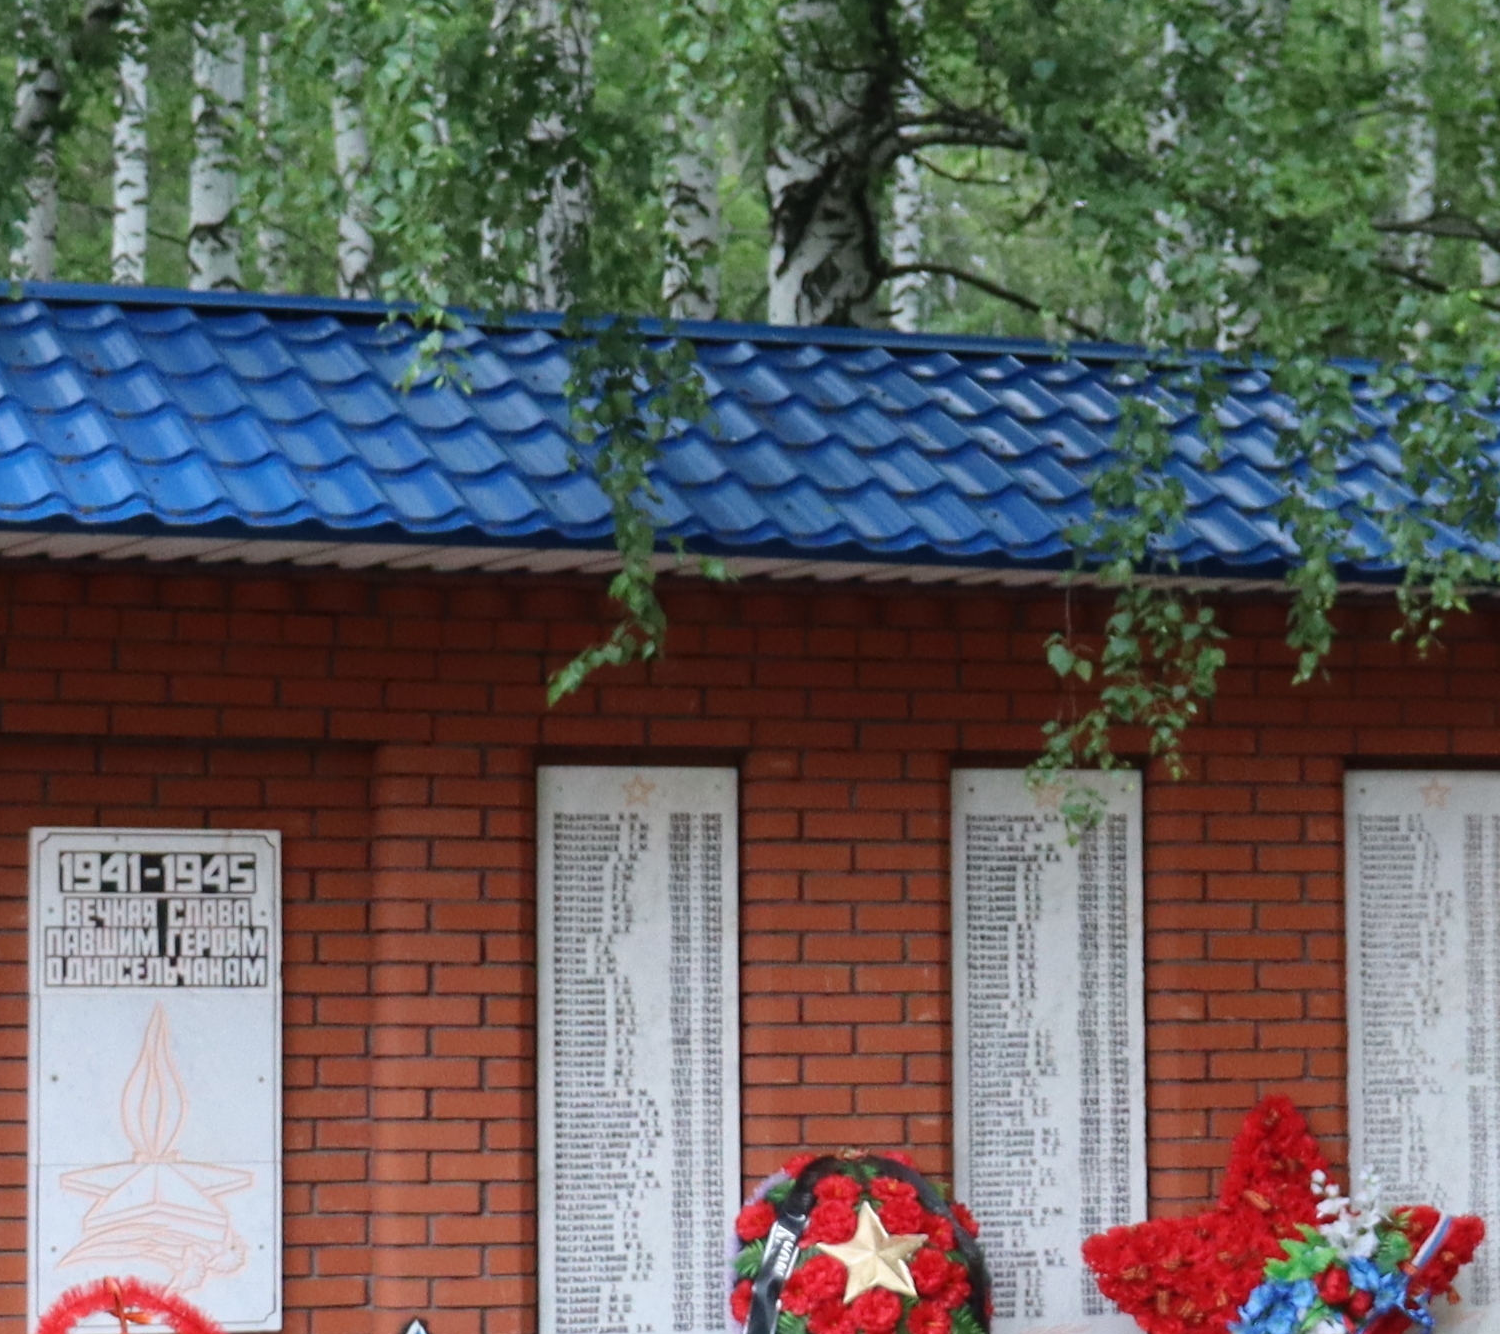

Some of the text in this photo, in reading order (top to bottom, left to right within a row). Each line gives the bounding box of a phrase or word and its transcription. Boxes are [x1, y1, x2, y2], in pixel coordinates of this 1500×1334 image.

[60, 852, 256, 893] 1941-1945
[64, 898, 251, 927] ВЕЧНАЯ СЛАВА
[46, 927, 266, 956] ПАВШИМ ГЕРОЯМ
[46, 957, 267, 986] ОДНОСЕЛЬЧАНАМ
